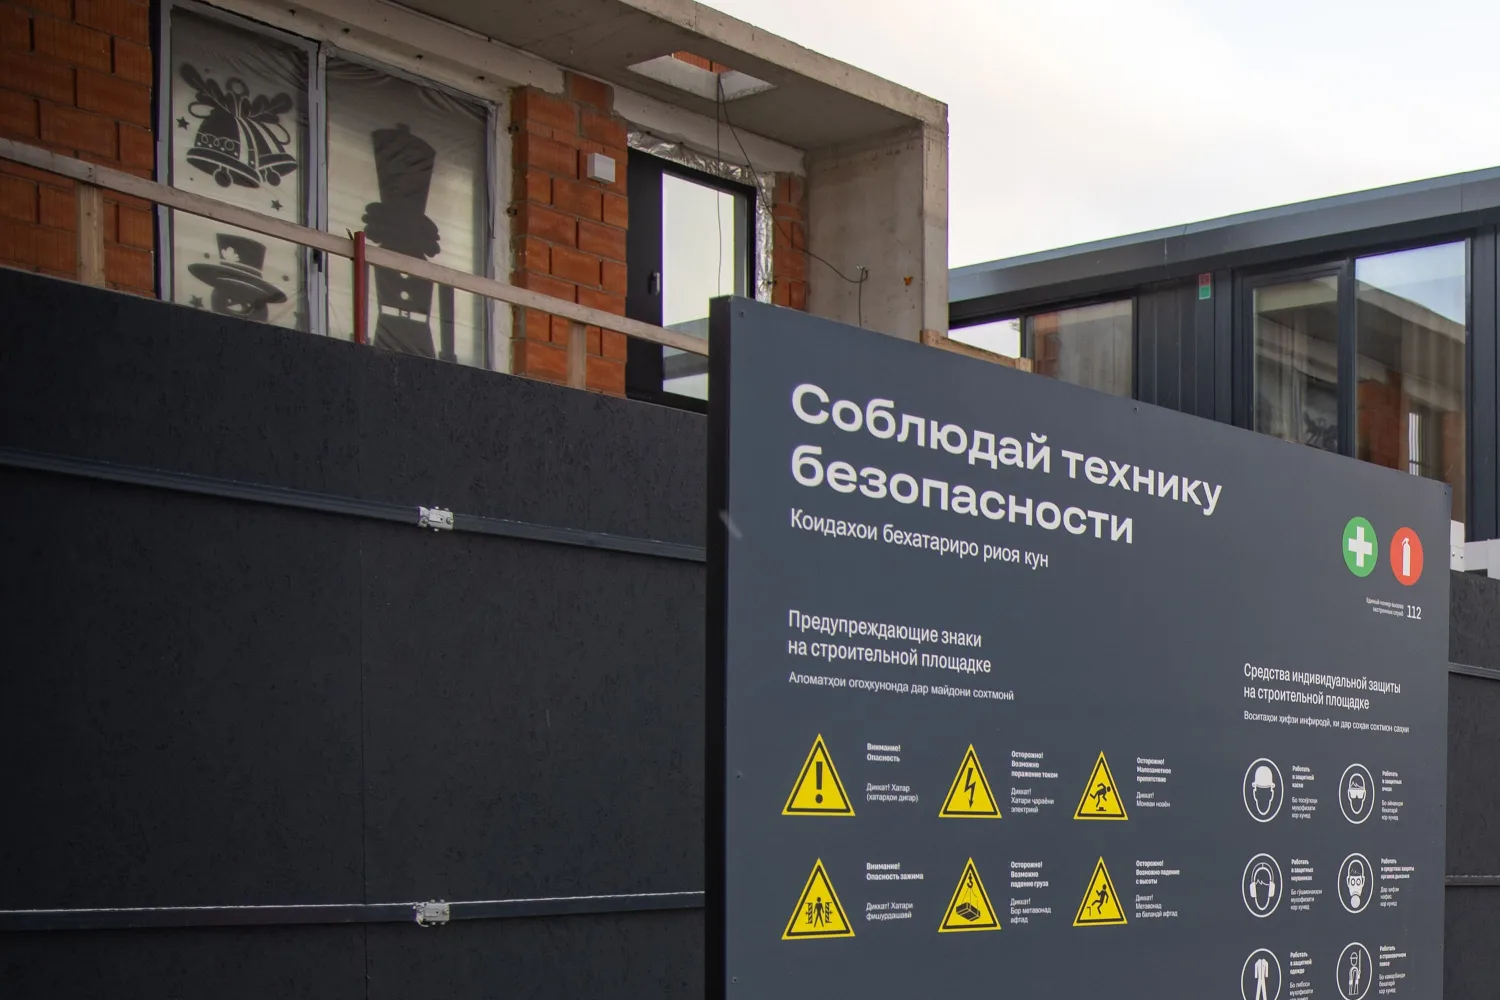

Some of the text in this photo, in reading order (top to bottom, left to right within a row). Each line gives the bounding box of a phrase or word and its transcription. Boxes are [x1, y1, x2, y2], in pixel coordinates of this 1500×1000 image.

[791, 383, 1222, 516] Соблюдай технику
[791, 445, 1133, 544] безопасности
[791, 508, 1049, 570] Коидахои бехатариро риоя кун
[1406, 605, 1422, 620] 112
[789, 609, 982, 647] Предупреждающие знаки
[788, 640, 991, 674] на строительной площадке
[1244, 663, 1401, 694] Средства индивидуальной защиты
[789, 671, 846, 687] Аломатҳои
[911, 684, 928, 696] дар
[931, 684, 970, 698] майдони
[1244, 686, 1369, 711] на строительной площадке
[1341, 721, 1351, 730] дар
[867, 742, 901, 752] Внимание!
[867, 753, 900, 762] Опасность
[1011, 750, 1043, 759] Осторожно!
[1011, 760, 1039, 768] Возможно
[1136, 757, 1165, 765] Осторожно!
[891, 784, 910, 793] Хатар
[1011, 797, 1031, 805] Хатари
[866, 862, 900, 870] Внимание!
[1010, 861, 1043, 870] Осторожно!
[1136, 859, 1164, 868] Осторожно!
[891, 902, 914, 910] Хатари
[1010, 907, 1021, 915] Бор
